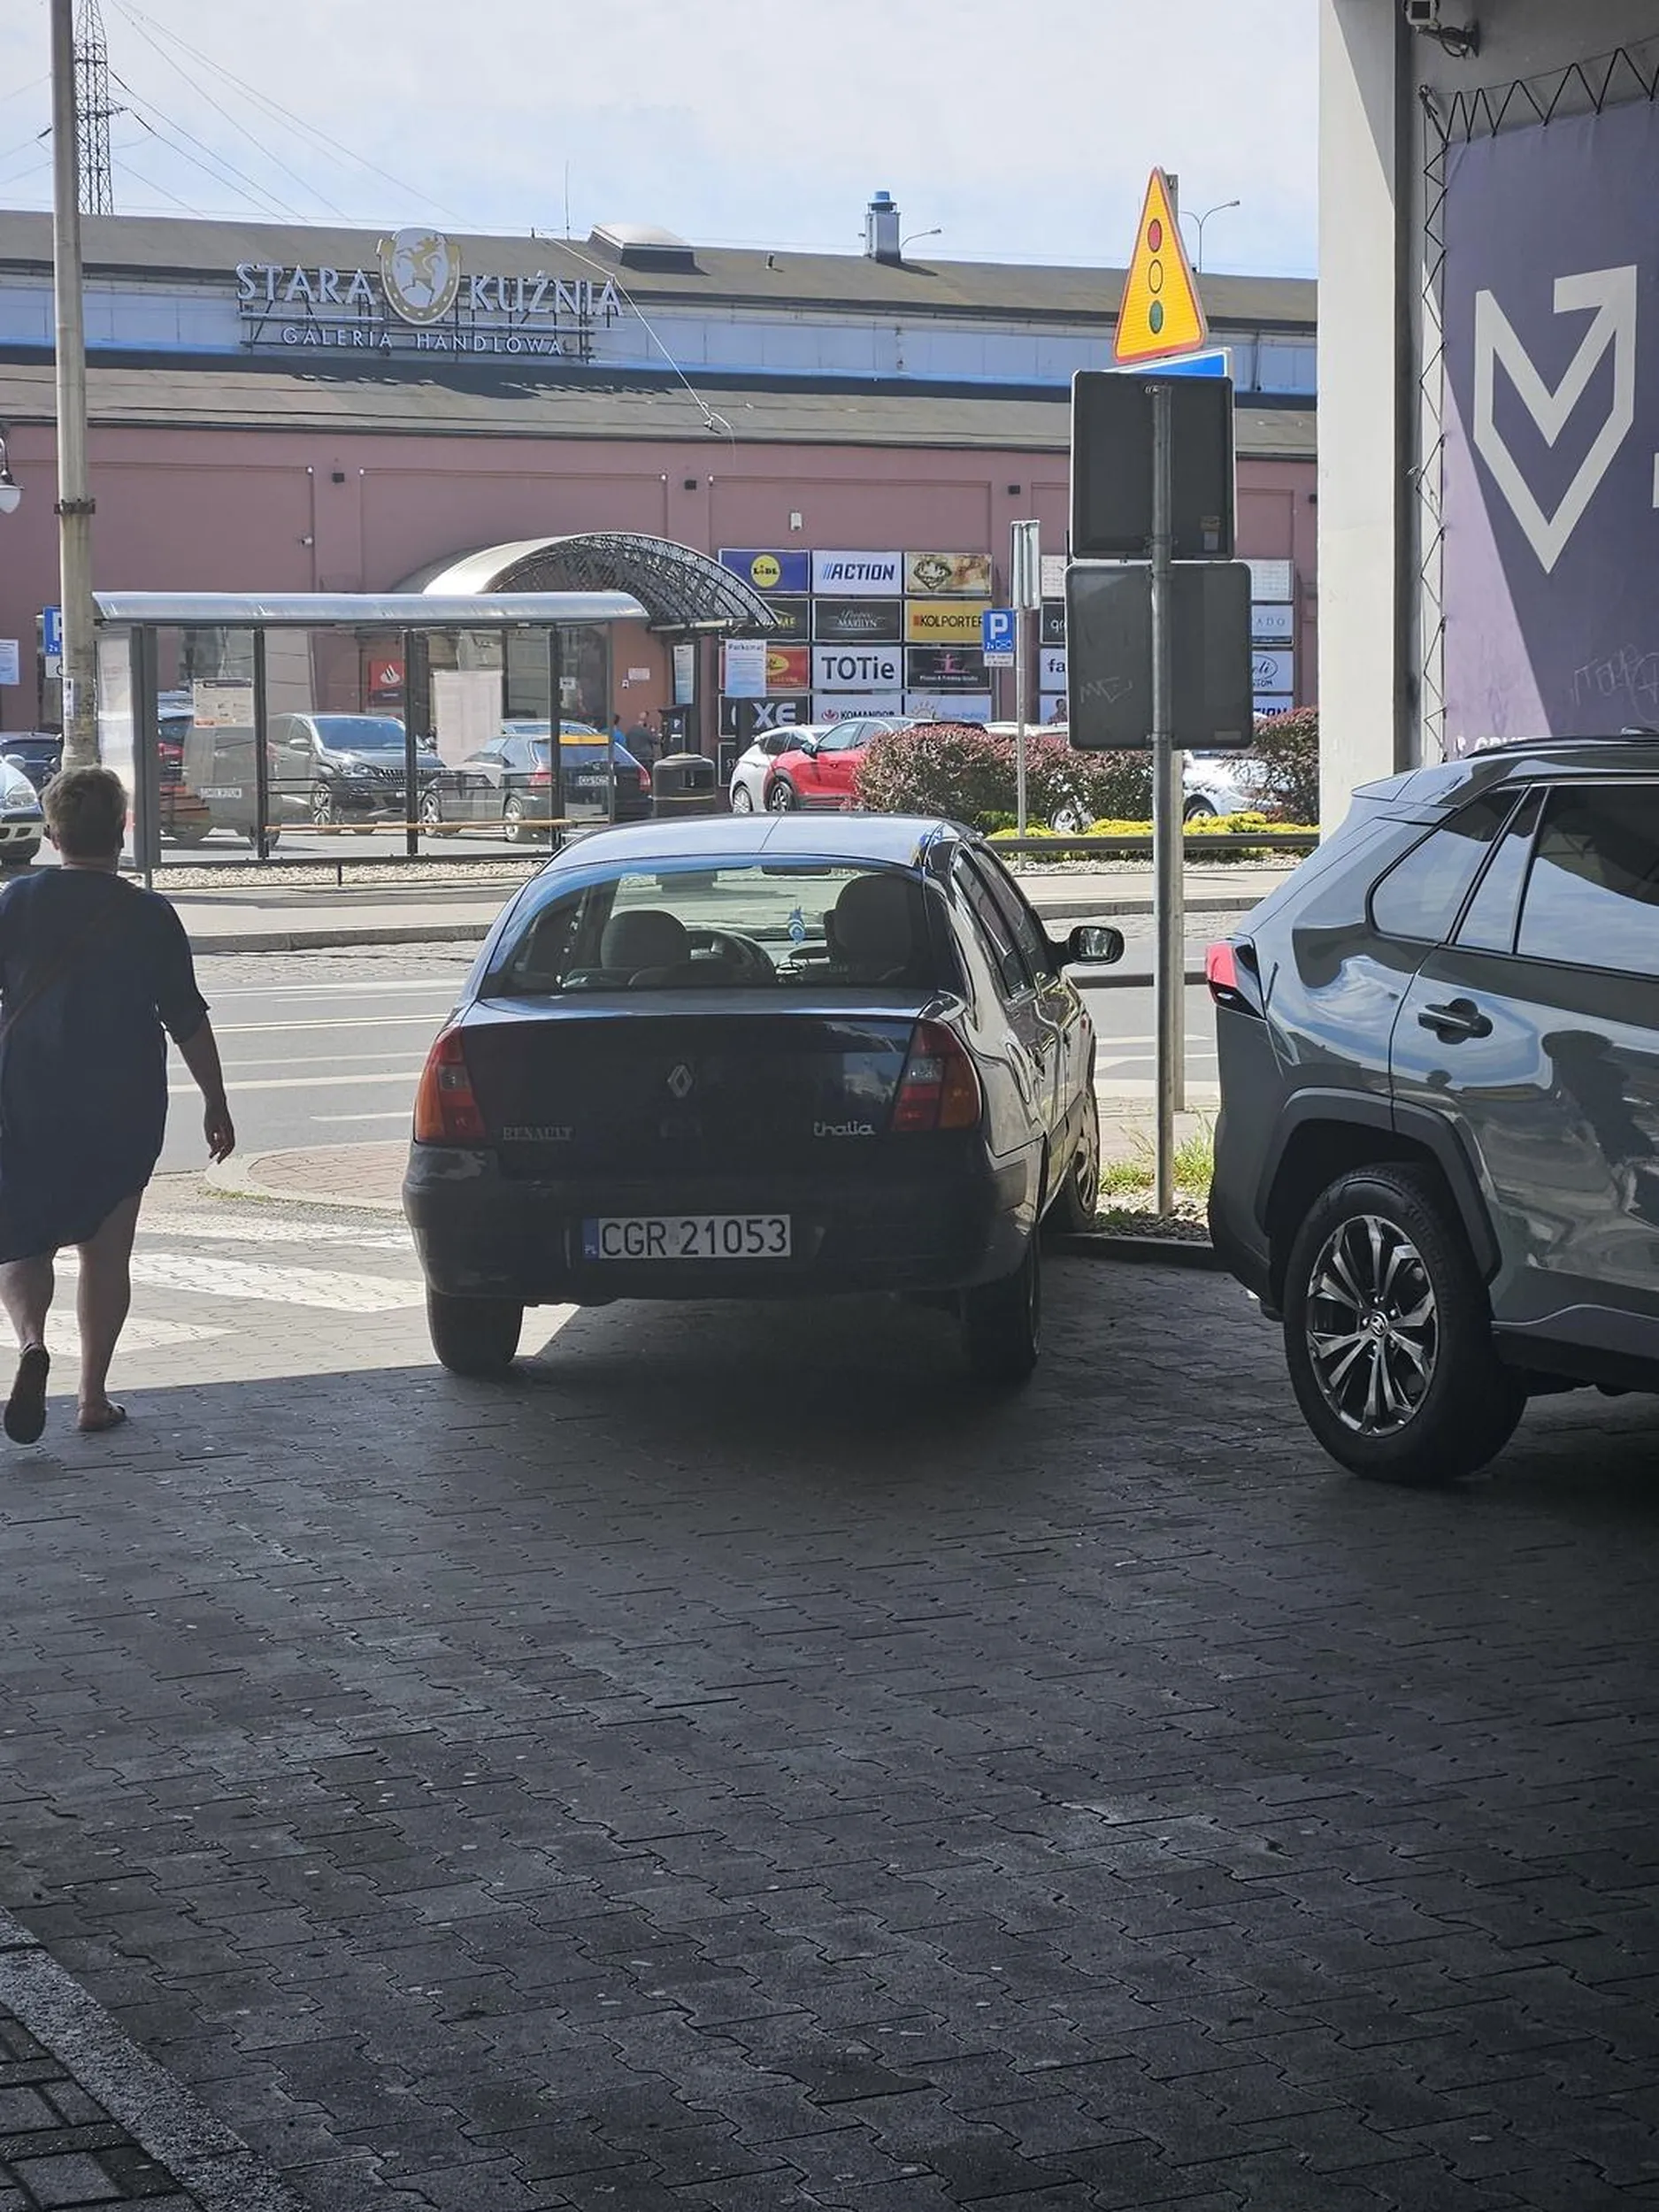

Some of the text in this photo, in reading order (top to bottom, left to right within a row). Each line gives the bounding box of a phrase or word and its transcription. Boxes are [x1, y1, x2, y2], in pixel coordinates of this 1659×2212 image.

[235, 264, 625, 317] STARA KUŹNIA
[281, 327, 563, 356] GALERIA HANDLOWA
[831, 563, 895, 581] ACTION
[990, 613, 1008, 640] P
[821, 656, 895, 680] TOTie
[503, 1125, 573, 1141] RENAULT
[813, 1119, 876, 1136] thalia
[601, 1218, 787, 1257] CGR 21053
